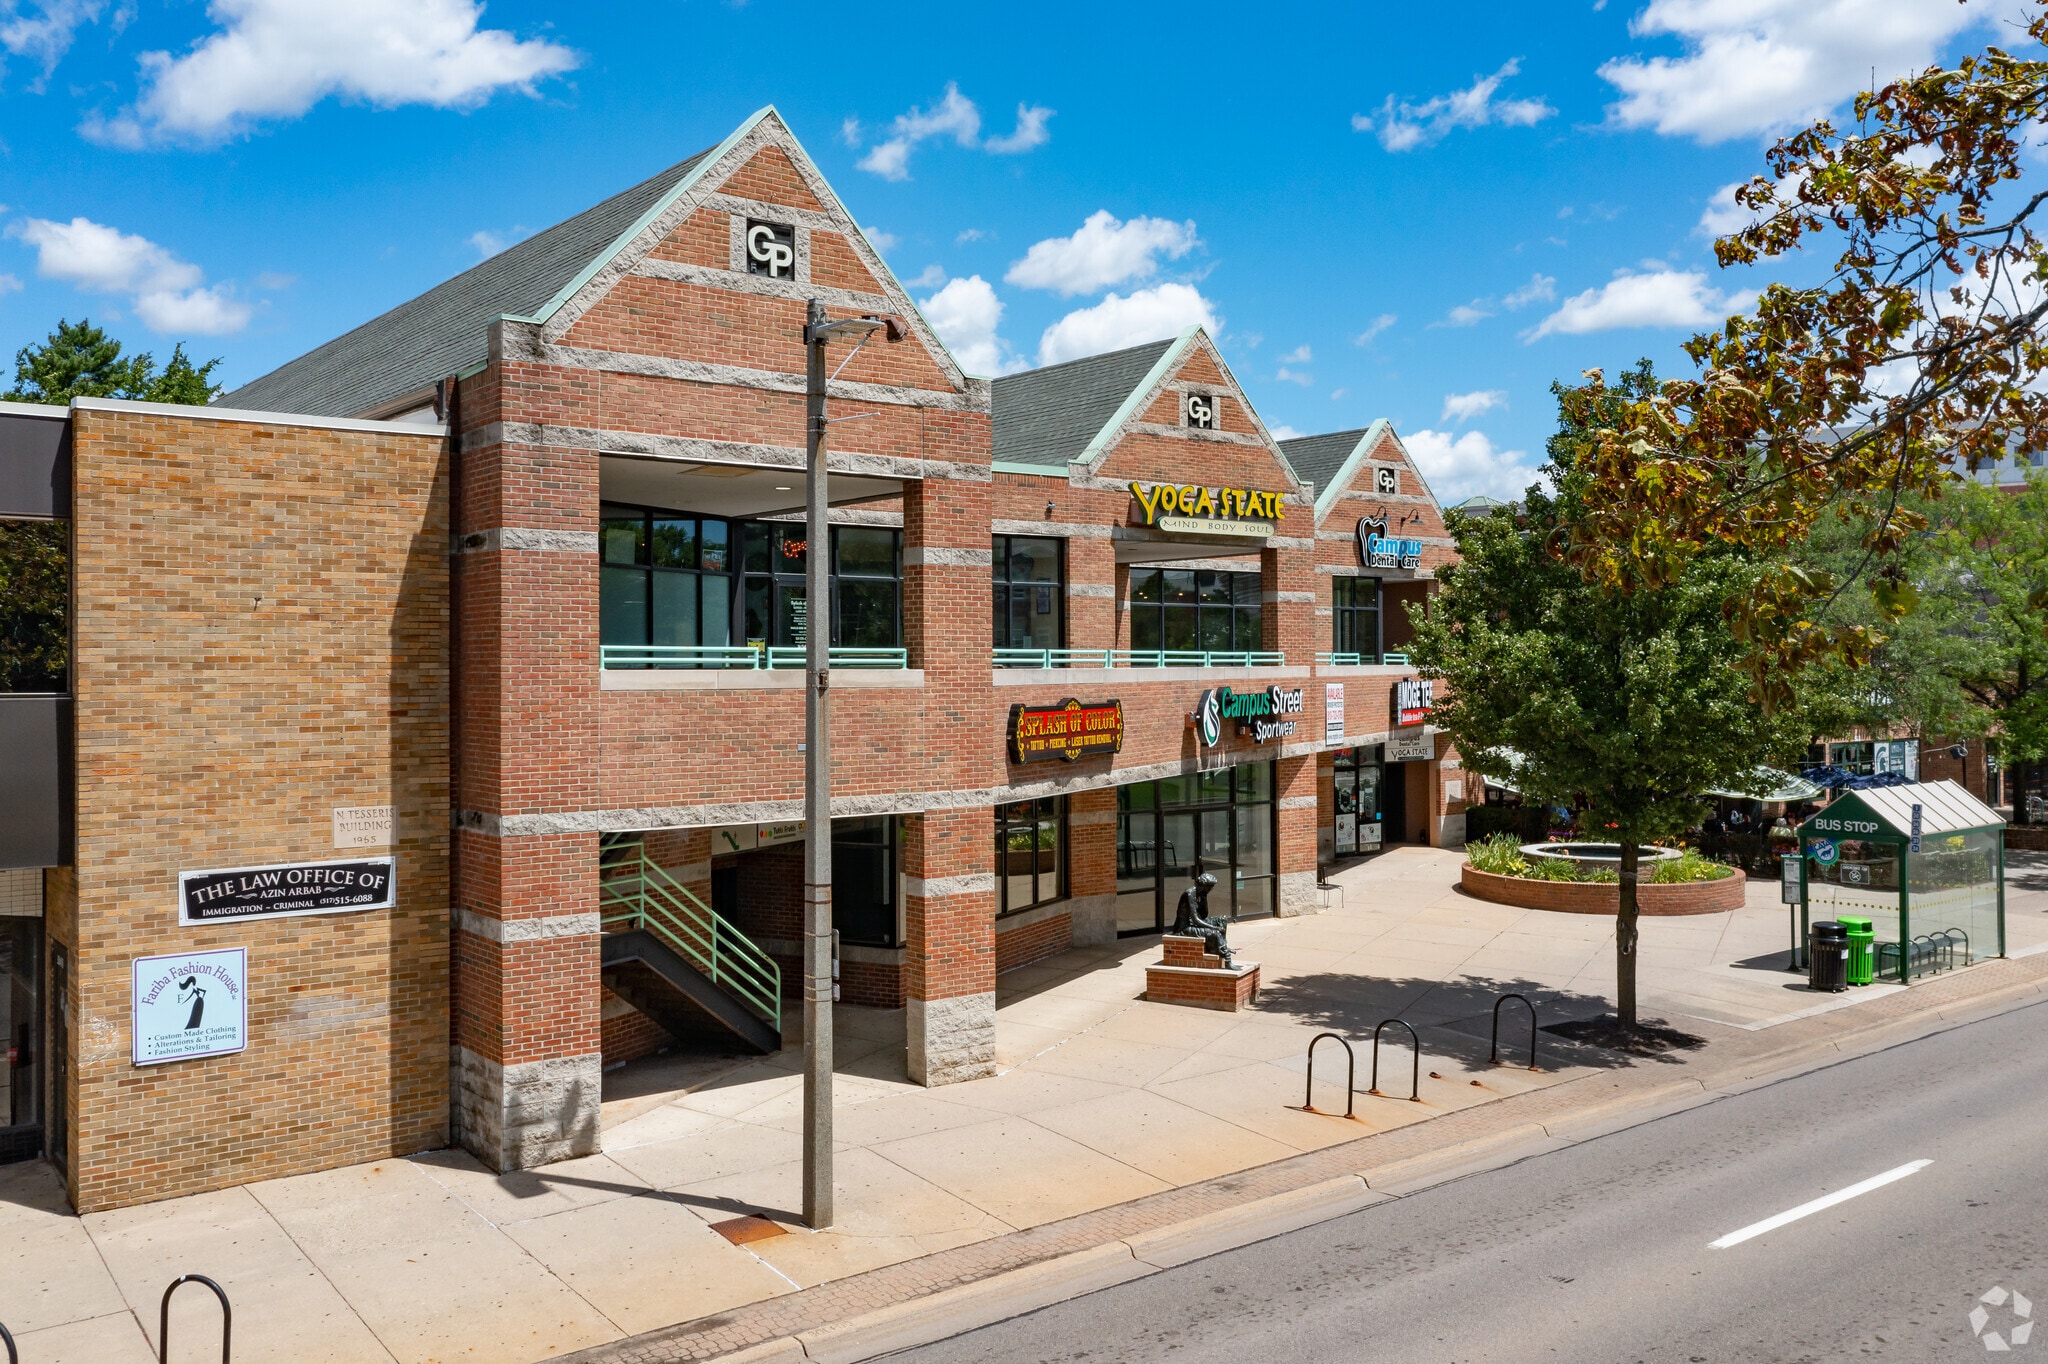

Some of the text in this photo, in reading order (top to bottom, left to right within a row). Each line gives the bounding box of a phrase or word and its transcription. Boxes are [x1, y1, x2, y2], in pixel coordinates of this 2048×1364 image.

[1130, 481, 1286, 525] YOGA STATE
[1162, 519, 1271, 534] MIND BODY SOUL
[1367, 532, 1423, 559] Campus
[1370, 554, 1421, 569] Dental Care
[1221, 685, 1304, 724] Campus Street
[1025, 710, 1116, 737] SPLASH OF COLOR
[1256, 719, 1297, 744] Sportwear
[1030, 733, 1112, 751] TATTOO PIERCING LASER TATTOO REMOVAL
[1391, 749, 1411, 761] YOGA
[1411, 747, 1429, 756] STATE
[347, 807, 395, 820] TESSERIS
[339, 820, 392, 833] BUILDING
[1815, 818, 1879, 833] BUS STOP
[353, 835, 377, 844] 1965
[191, 869, 385, 905] THE LAW OFFICE OF
[259, 886, 322, 899] AZIN ARBAB
[202, 904, 264, 917] IMMIGRATION
[273, 900, 315, 911] CRIMINAL
[141, 961, 239, 1006] Fariba Fashion House
[154, 1025, 237, 1042] Custom Made Clothing
[154, 1038, 194, 1049] Alterations
[204, 1032, 237, 1042] Tailoring
[154, 1043, 210, 1056] Fashion Styling
